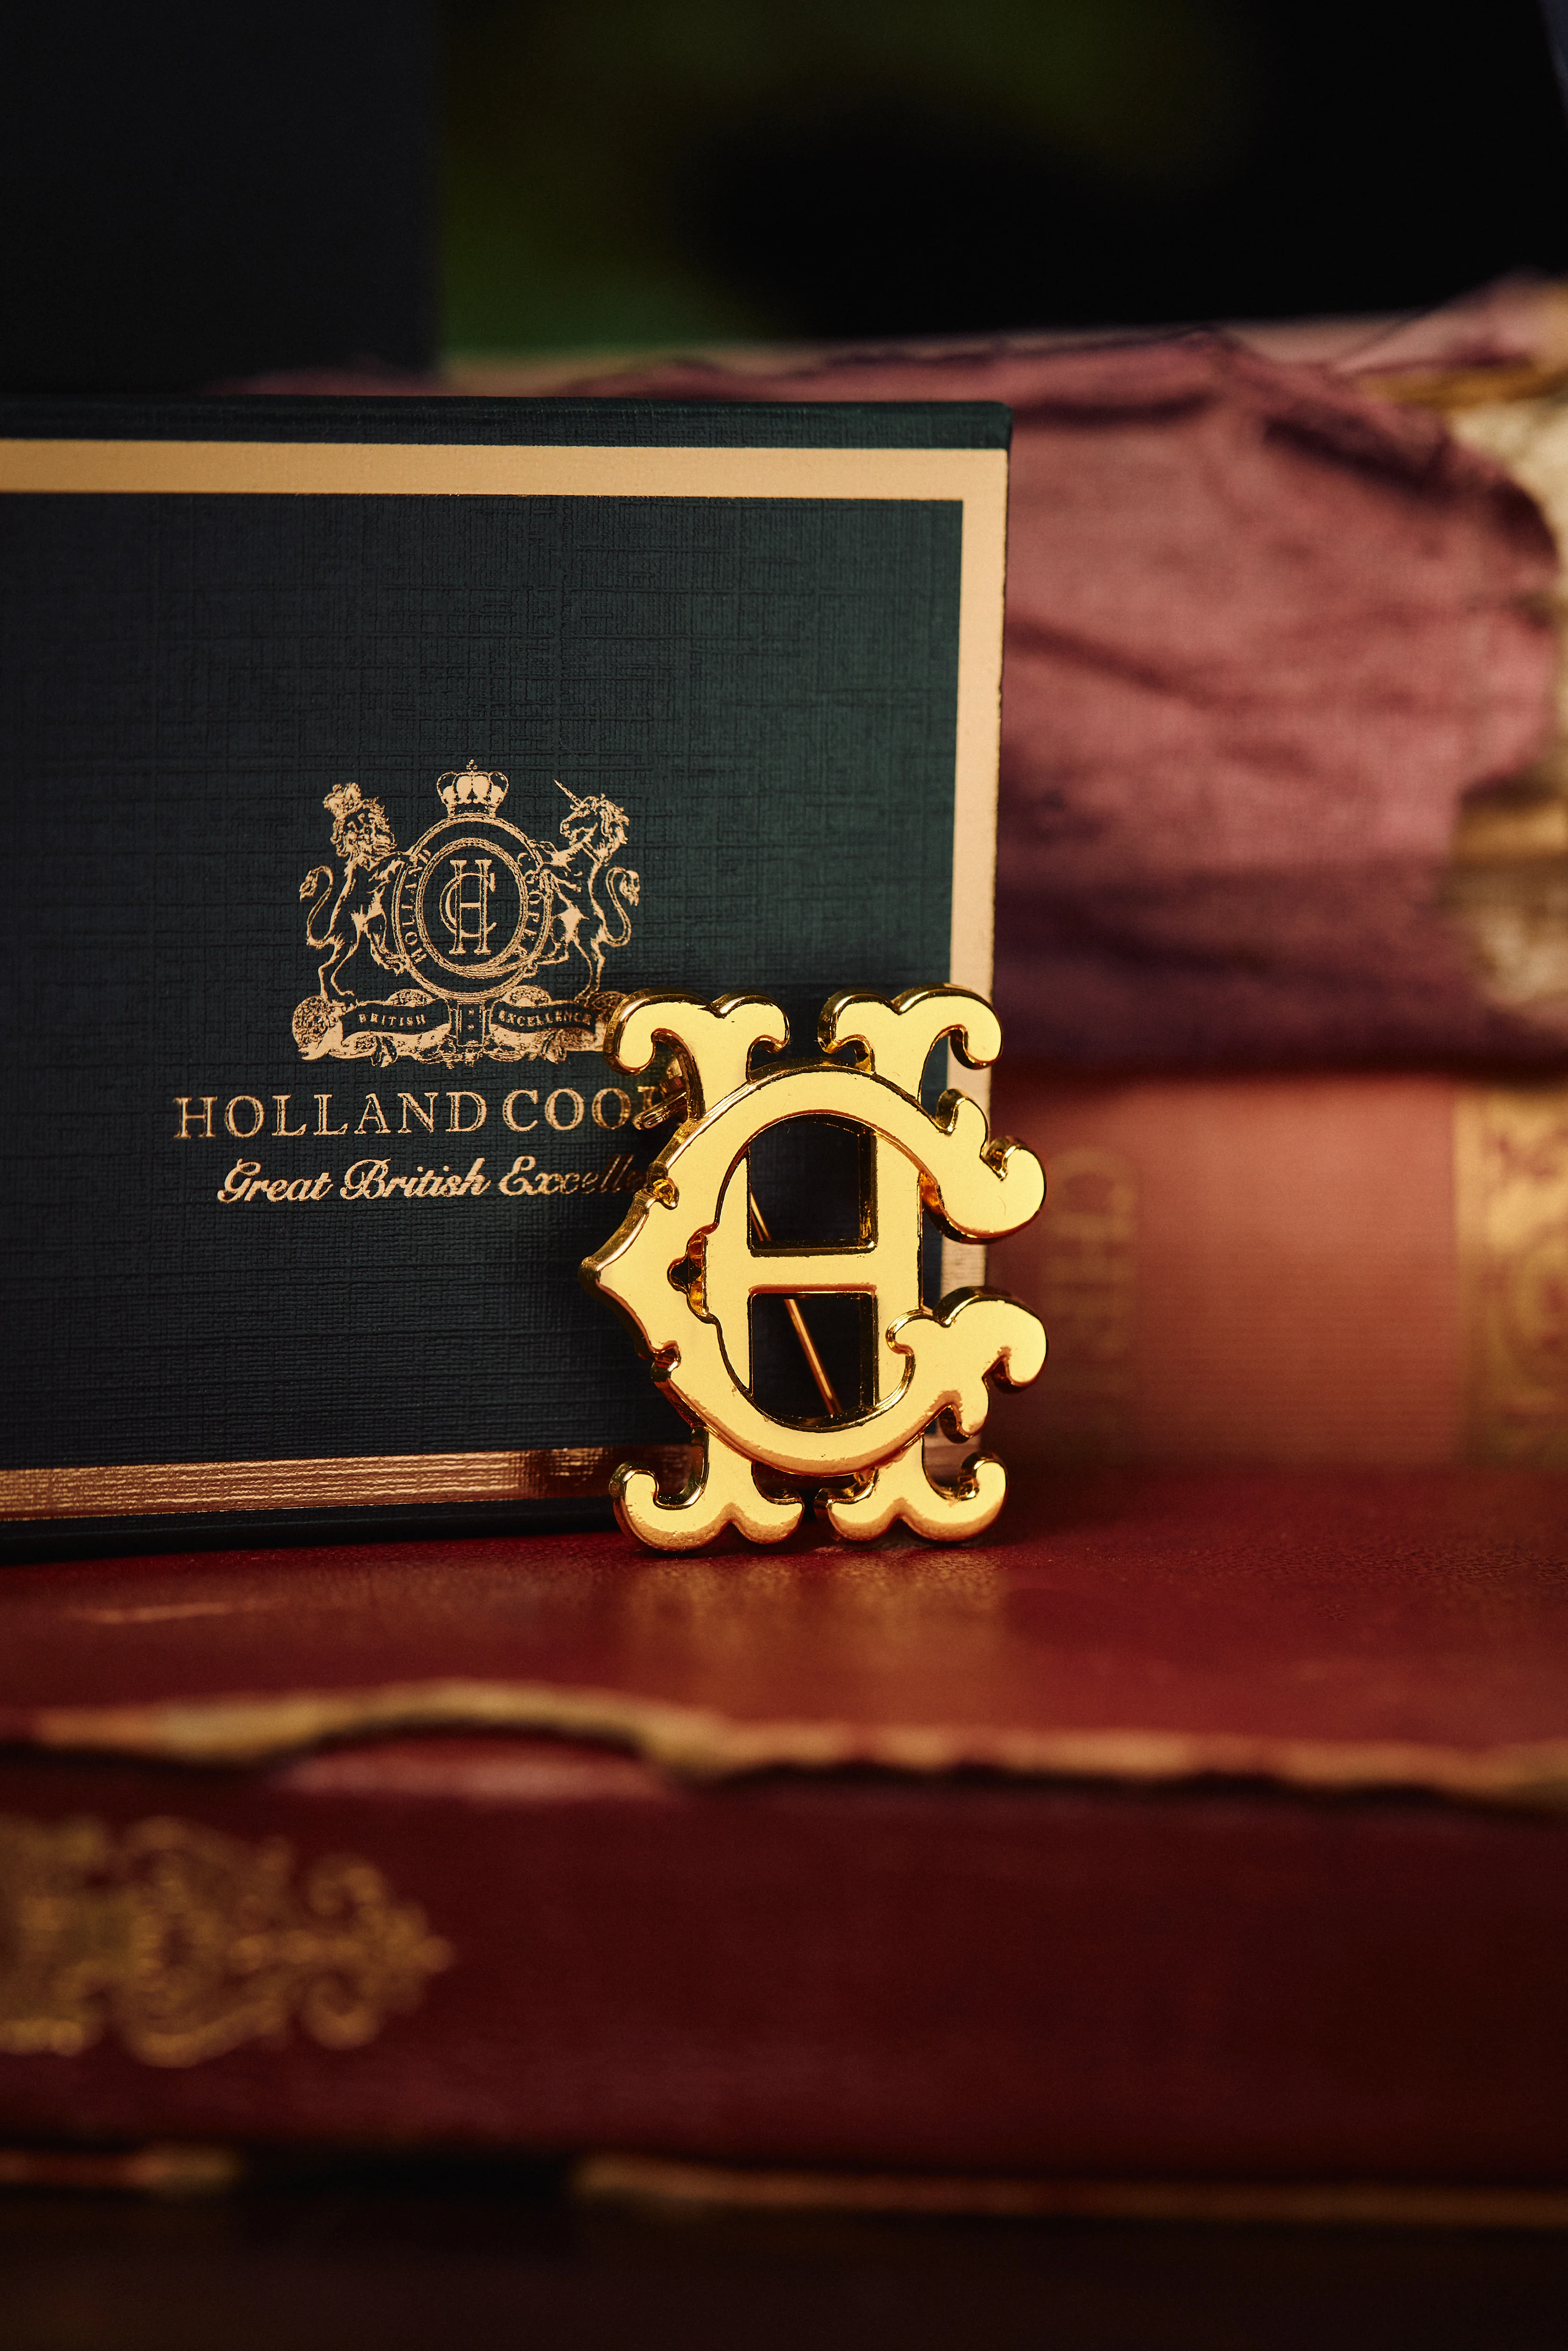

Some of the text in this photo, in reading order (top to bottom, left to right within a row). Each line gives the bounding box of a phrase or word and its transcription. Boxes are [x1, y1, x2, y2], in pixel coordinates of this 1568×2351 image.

[357, 1009, 592, 1027] BRITISH EXCELLENCE
[173, 1090, 488, 1139] HOLLAND
[217, 1154, 649, 1203] Great British Excelle
